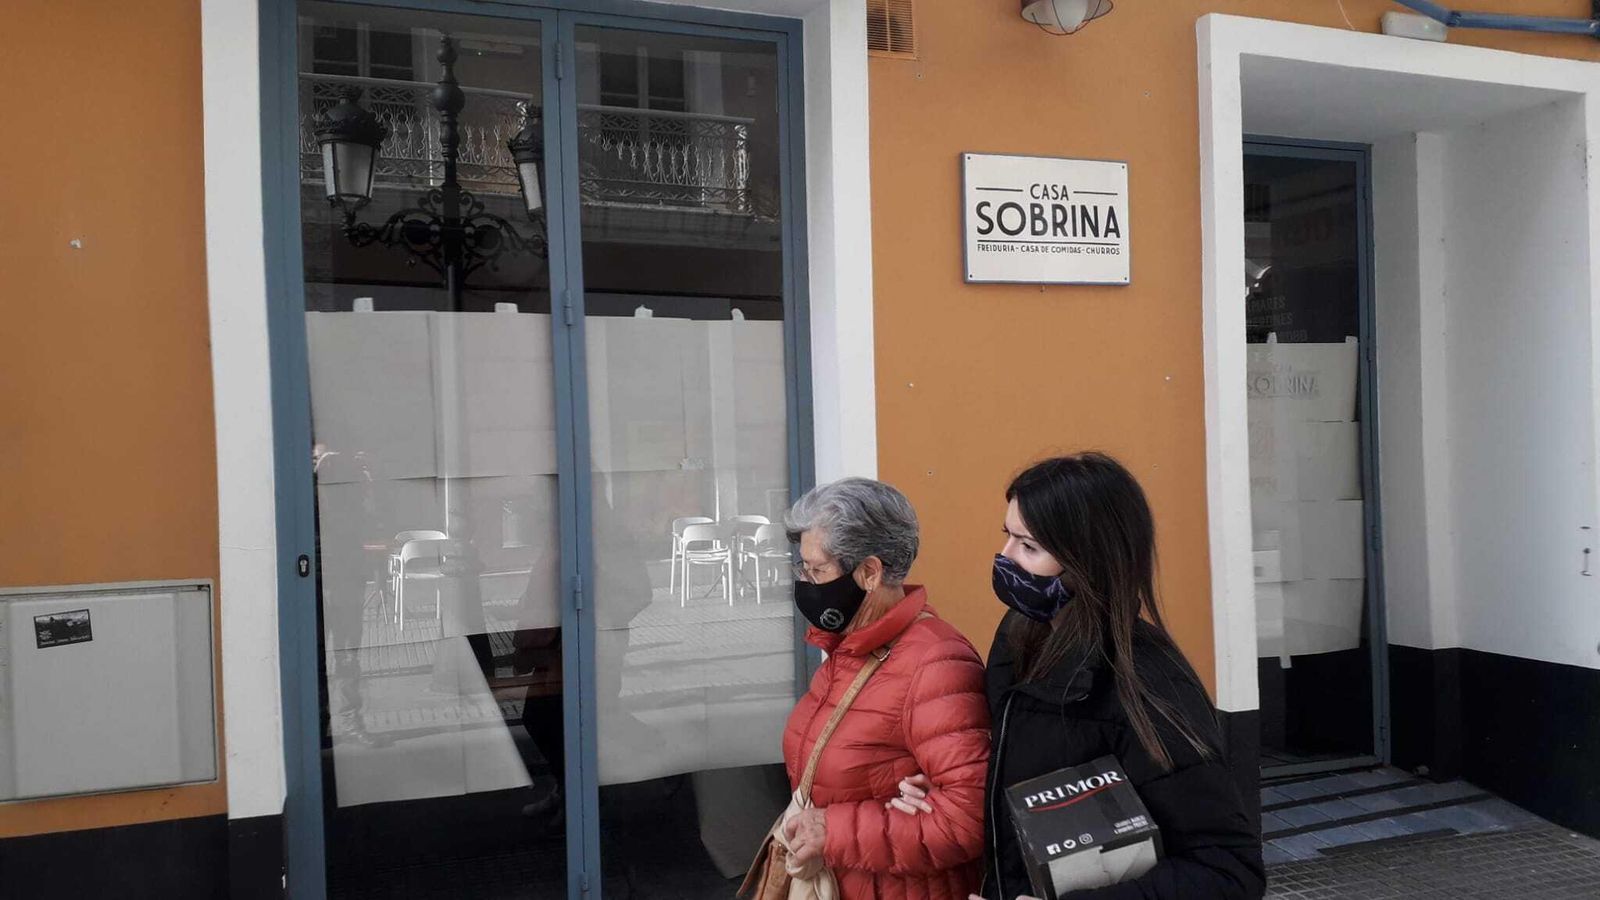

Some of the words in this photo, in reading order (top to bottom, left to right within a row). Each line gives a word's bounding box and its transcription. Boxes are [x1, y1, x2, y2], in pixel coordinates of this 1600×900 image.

[1030, 183, 1069, 201] CASA
[976, 201, 1121, 239] SOBRINA
[977, 244, 1015, 252] FREIDURIA
[1020, 245, 1040, 253] CASA
[1041, 245, 1049, 253] DE
[1051, 246, 1081, 254] COMIDAS
[1086, 247, 1120, 255] CHURROS
[1024, 770, 1122, 808] PRIMOR
